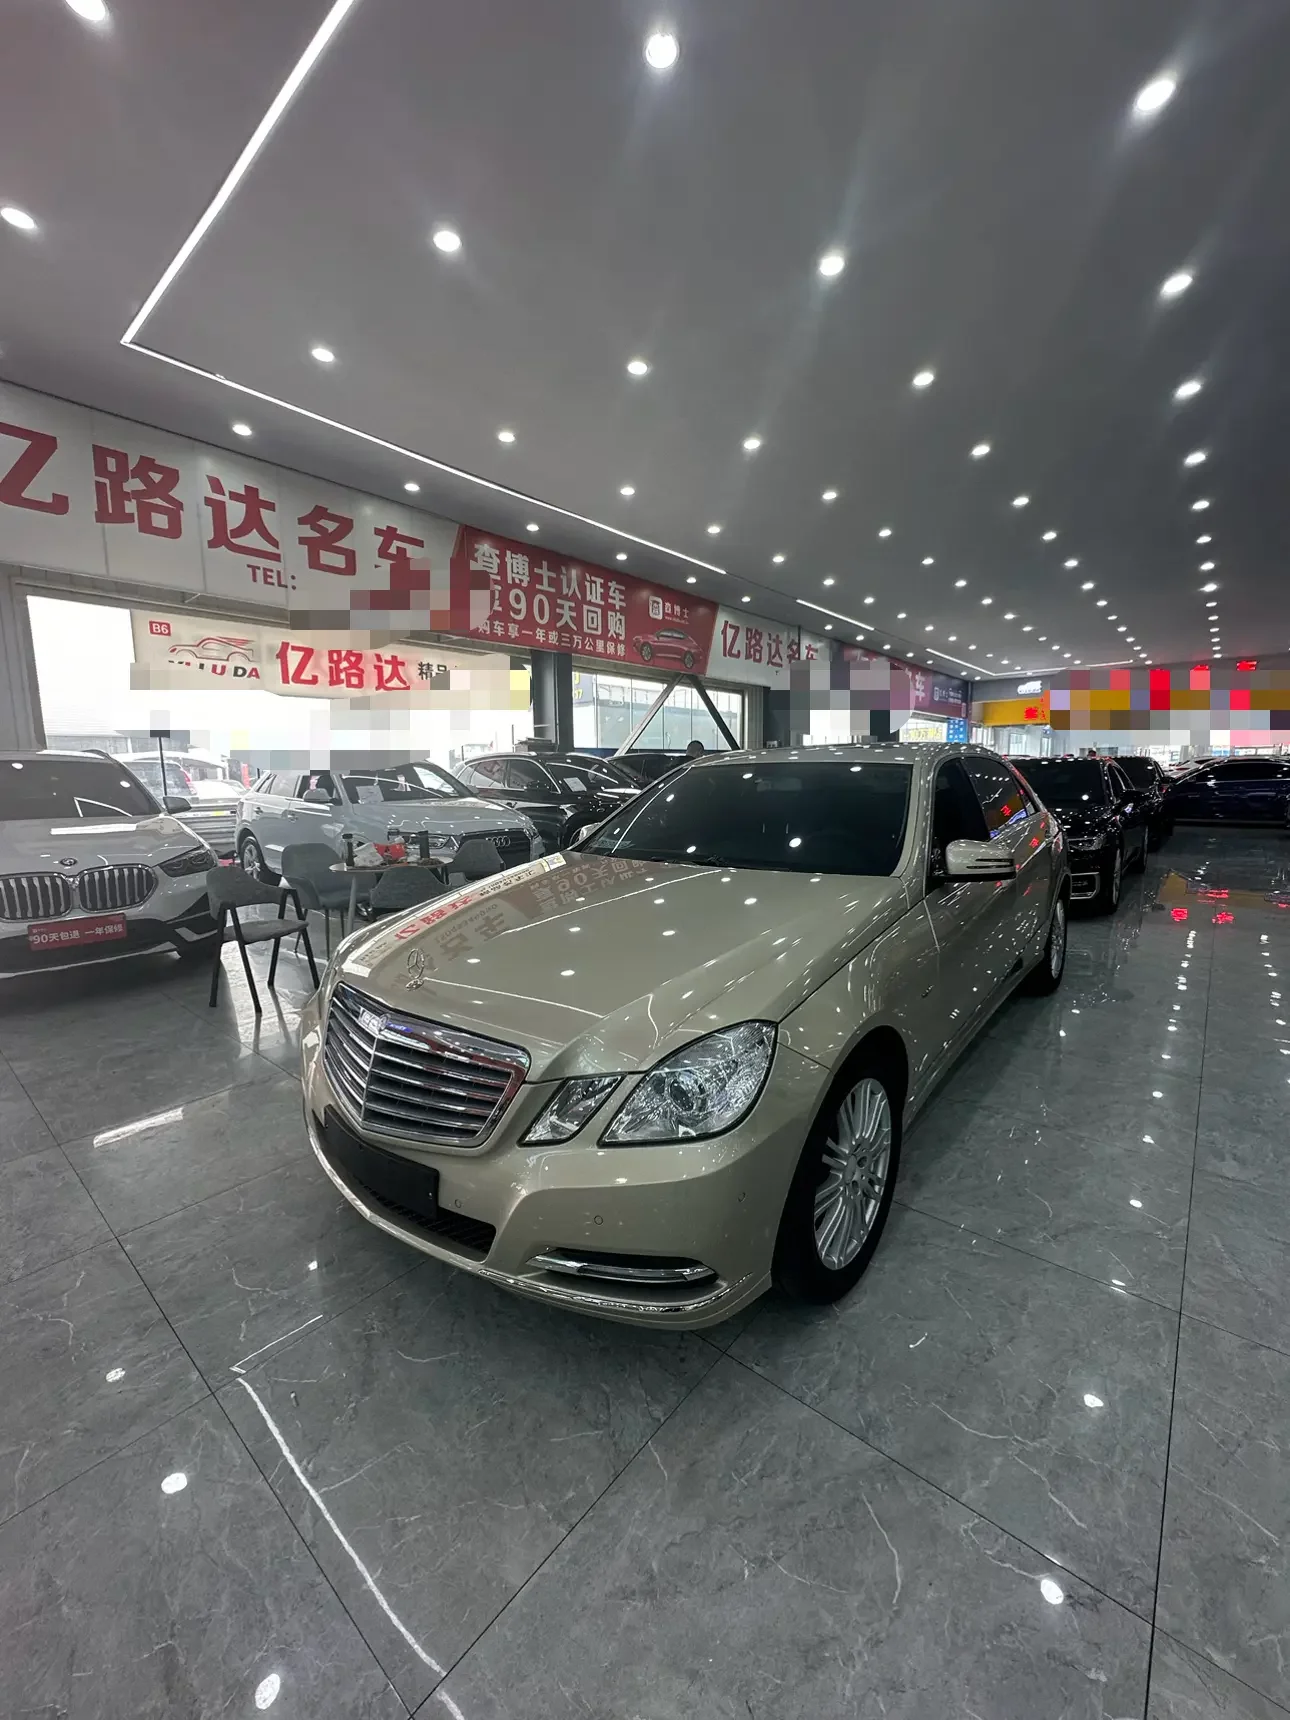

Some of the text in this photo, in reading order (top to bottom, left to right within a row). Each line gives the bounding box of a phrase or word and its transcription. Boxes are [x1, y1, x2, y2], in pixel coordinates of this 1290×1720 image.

[246, 564, 297, 590] TEL:
[474, 543, 626, 611] 查博士认证车
[152, 623, 169, 635] B6
[276, 641, 410, 691] 亿路达
[33, 930, 80, 944] 90天包退
[84, 924, 123, 936] 一年保修
